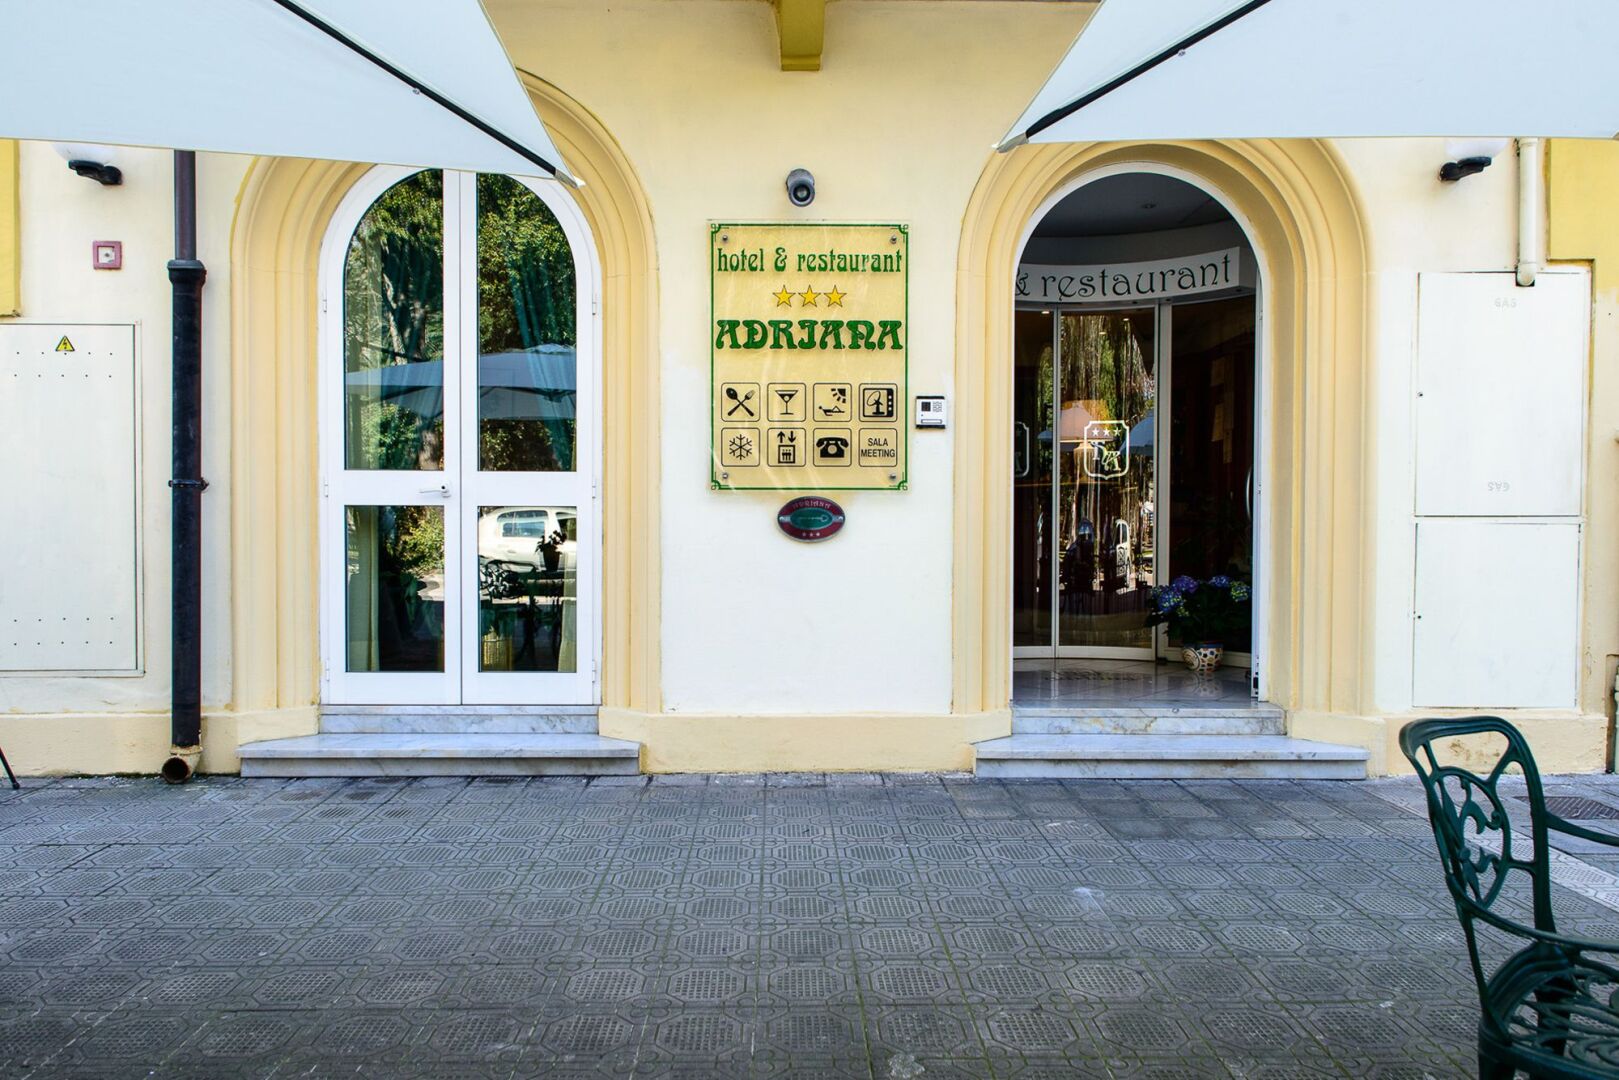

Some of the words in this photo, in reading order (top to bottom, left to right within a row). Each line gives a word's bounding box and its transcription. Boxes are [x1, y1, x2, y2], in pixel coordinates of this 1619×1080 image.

[717, 248, 764, 272] hotel
[774, 246, 788, 272] &
[797, 249, 902, 272] restaurant
[1041, 253, 1231, 301] restaurant
[868, 437, 889, 447] SALA
[861, 448, 896, 458] MEETING
